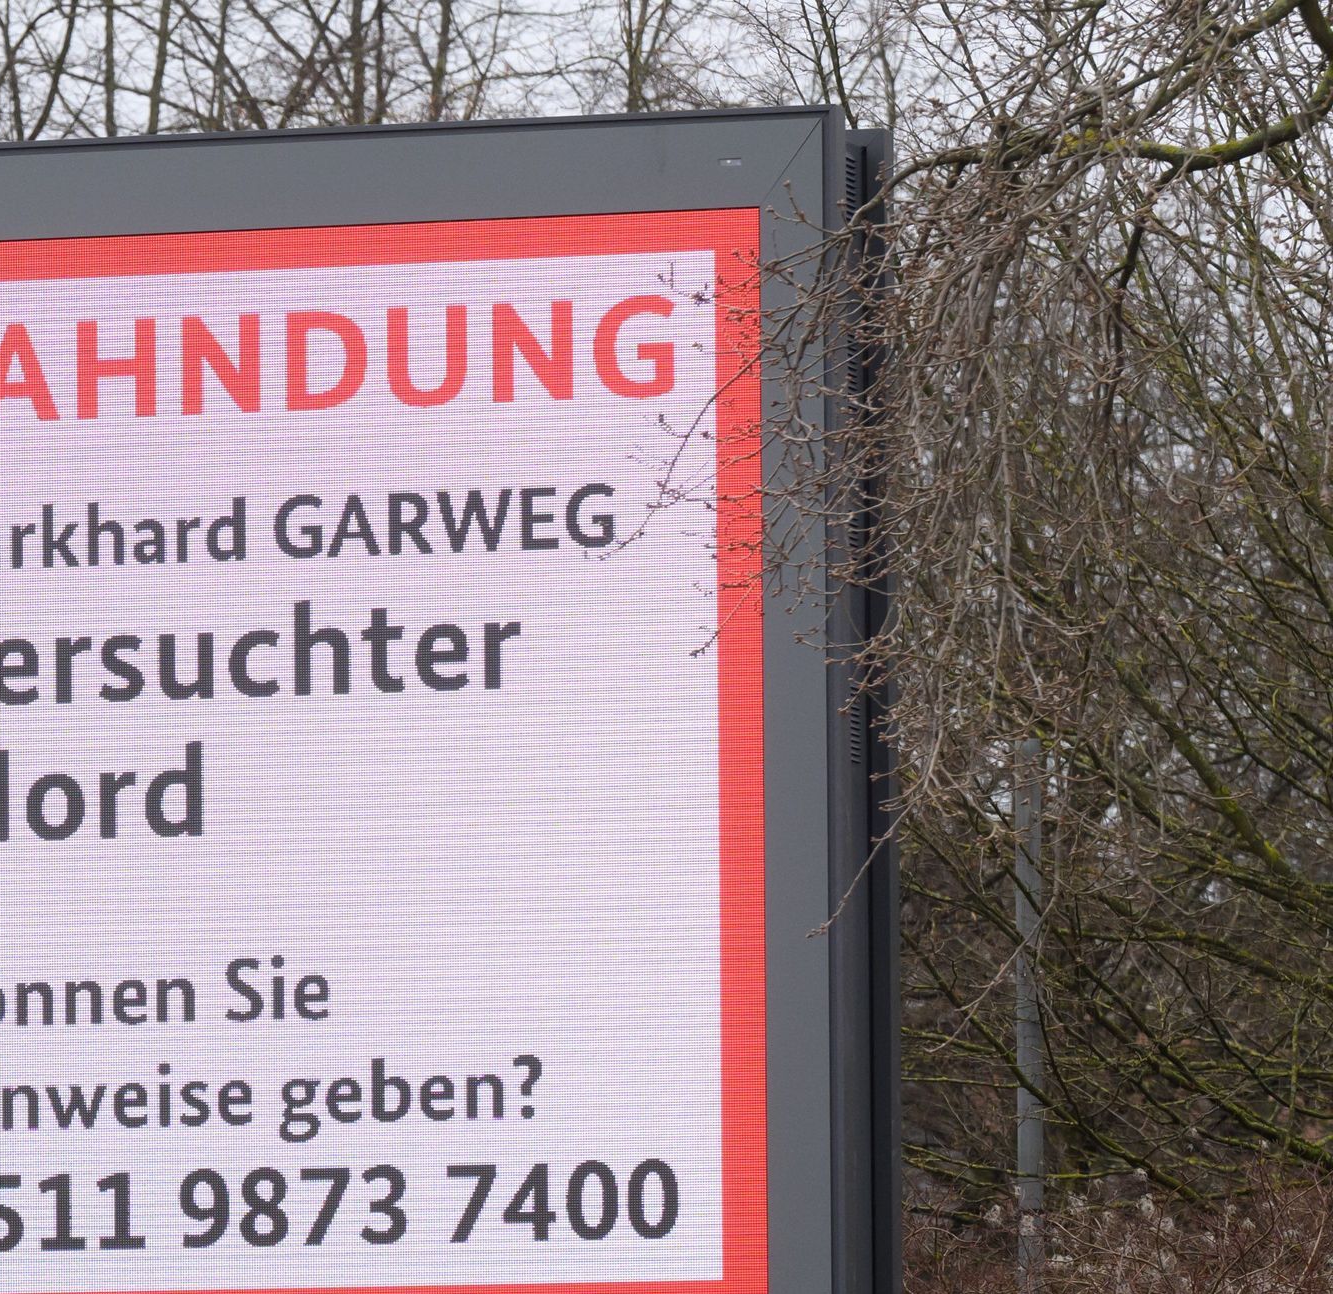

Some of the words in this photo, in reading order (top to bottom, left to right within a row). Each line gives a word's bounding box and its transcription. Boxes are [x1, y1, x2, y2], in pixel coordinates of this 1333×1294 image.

[274, 483, 617, 560] GARWEG
[224, 955, 331, 1023] Sie
[278, 1054, 543, 1143] geben?
[179, 1164, 408, 1248] 9873
[445, 1157, 679, 1243] 7400
